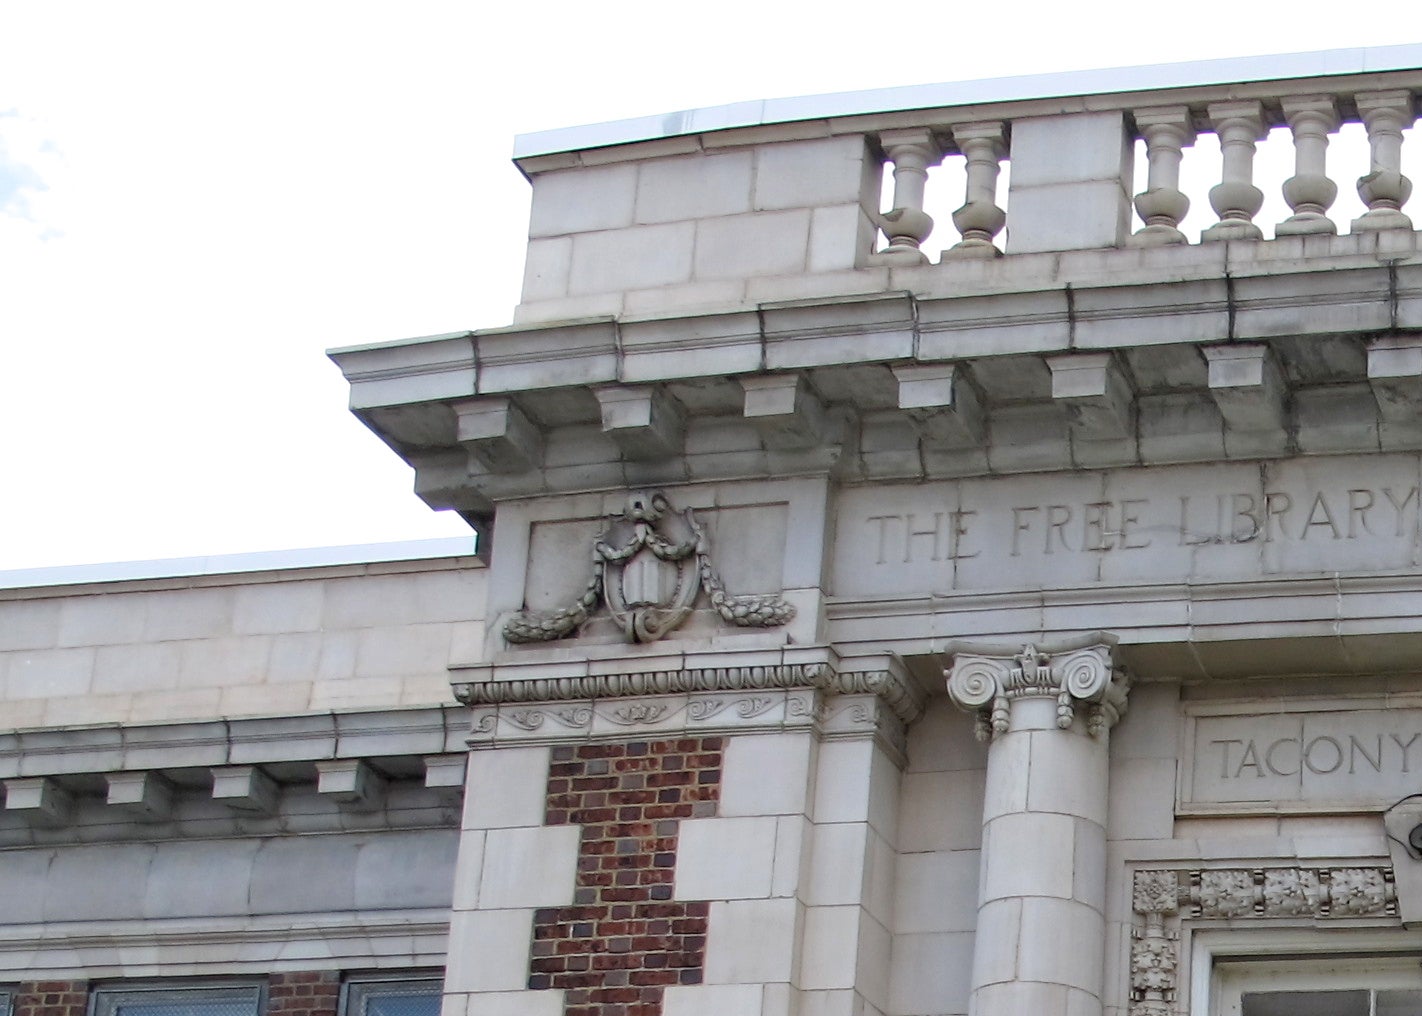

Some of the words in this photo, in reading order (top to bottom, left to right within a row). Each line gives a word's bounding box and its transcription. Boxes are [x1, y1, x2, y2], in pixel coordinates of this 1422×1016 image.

[868, 508, 983, 565] THE
[1009, 498, 1151, 556] FREE
[1178, 487, 1420, 546] LIBRARY
[1210, 732, 1421, 780] TACONY
